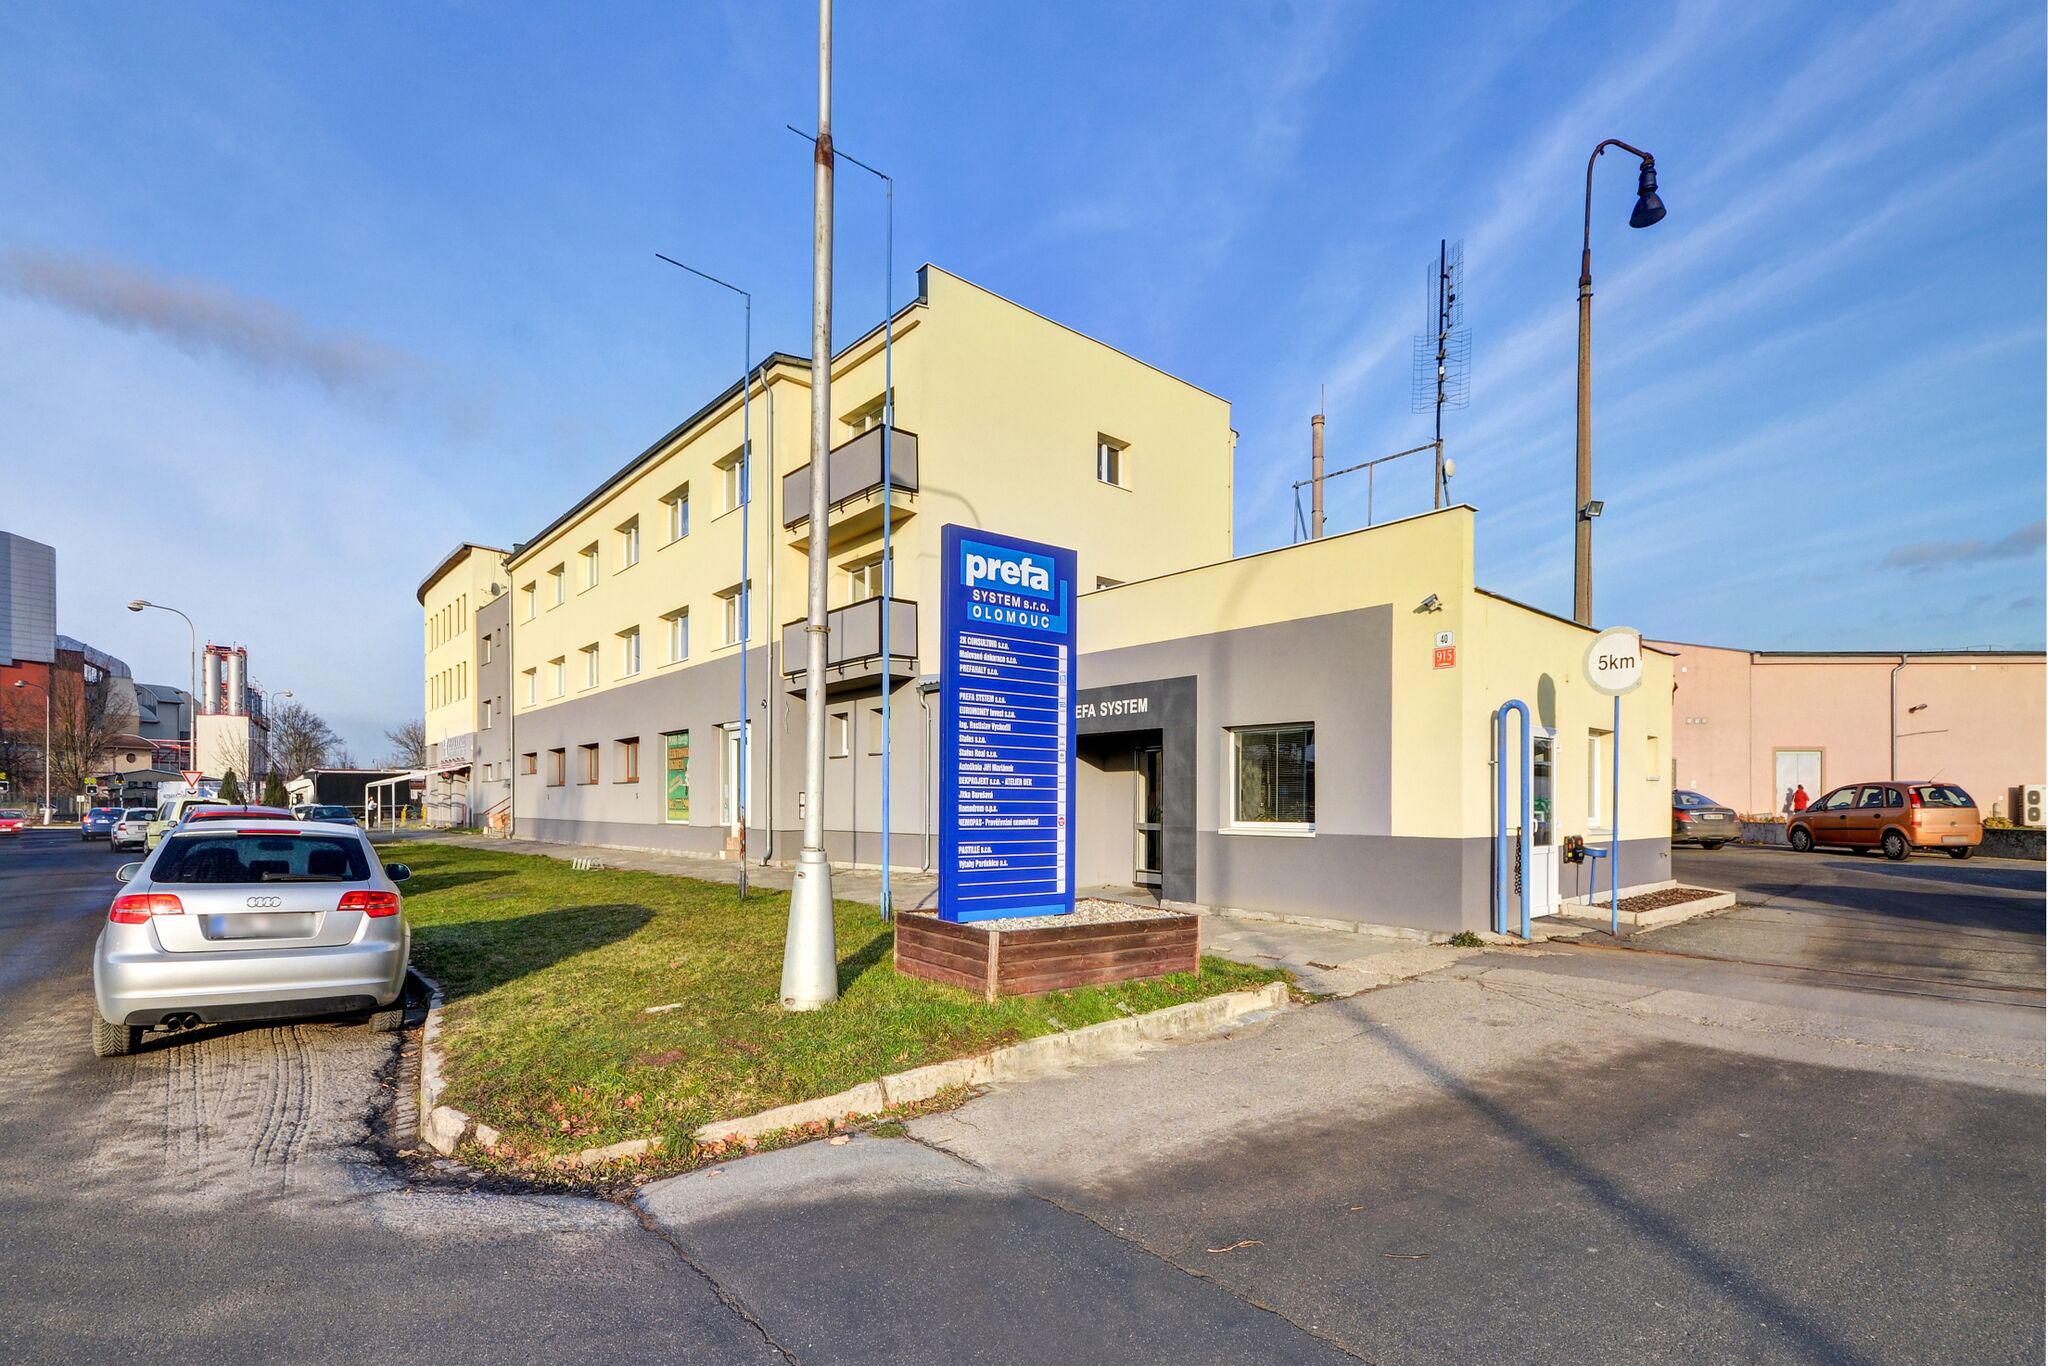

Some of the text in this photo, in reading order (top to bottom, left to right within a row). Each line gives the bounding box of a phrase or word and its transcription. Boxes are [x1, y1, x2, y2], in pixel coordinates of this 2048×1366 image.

[966, 553, 1049, 592] prefa
[973, 589, 1050, 612] SYSTEM s.r.o.
[973, 605, 1049, 628] OLOMOUC
[967, 637, 997, 648] CONSULTING
[998, 642, 1009, 650] s.r.o.
[1440, 633, 1449, 644] 40
[1006, 657, 1017, 665] s.r.o.
[1437, 650, 1452, 662] 915
[1598, 654, 1634, 671] 5km
[987, 668, 999, 676] s.r.o.
[959, 692, 1006, 704] PREFA SYSTEM s.r.o.
[959, 706, 989, 716] EUROMONEY
[1076, 698, 1148, 719] EFA SYSTEM
[959, 720, 969, 729] Ing.
[959, 776, 988, 785] DEKPROJEKT
[1005, 778, 1022, 786] ATELIER
[1023, 778, 1033, 786] DEK
[959, 790, 971, 799] Jitka
[958, 845, 992, 854] PASTILLE s.r.o.
